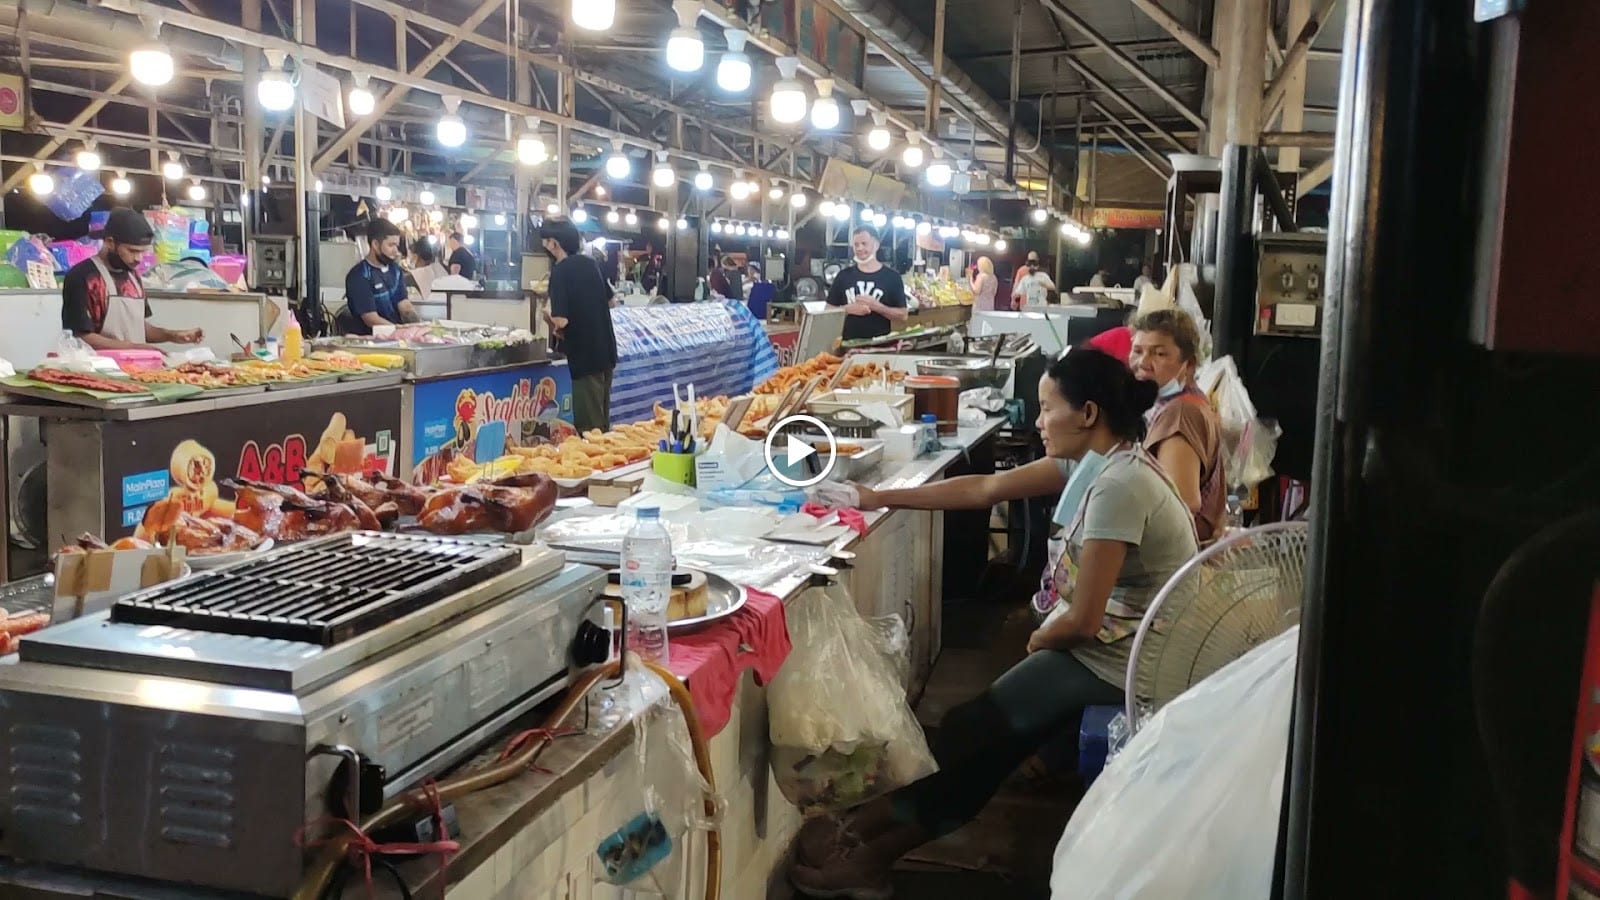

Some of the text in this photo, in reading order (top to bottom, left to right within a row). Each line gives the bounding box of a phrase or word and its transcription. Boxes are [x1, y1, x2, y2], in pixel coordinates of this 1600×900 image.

[480, 383, 544, 433] Seafood
[237, 433, 306, 484] A&B
[125, 479, 167, 493] MainPlaza
